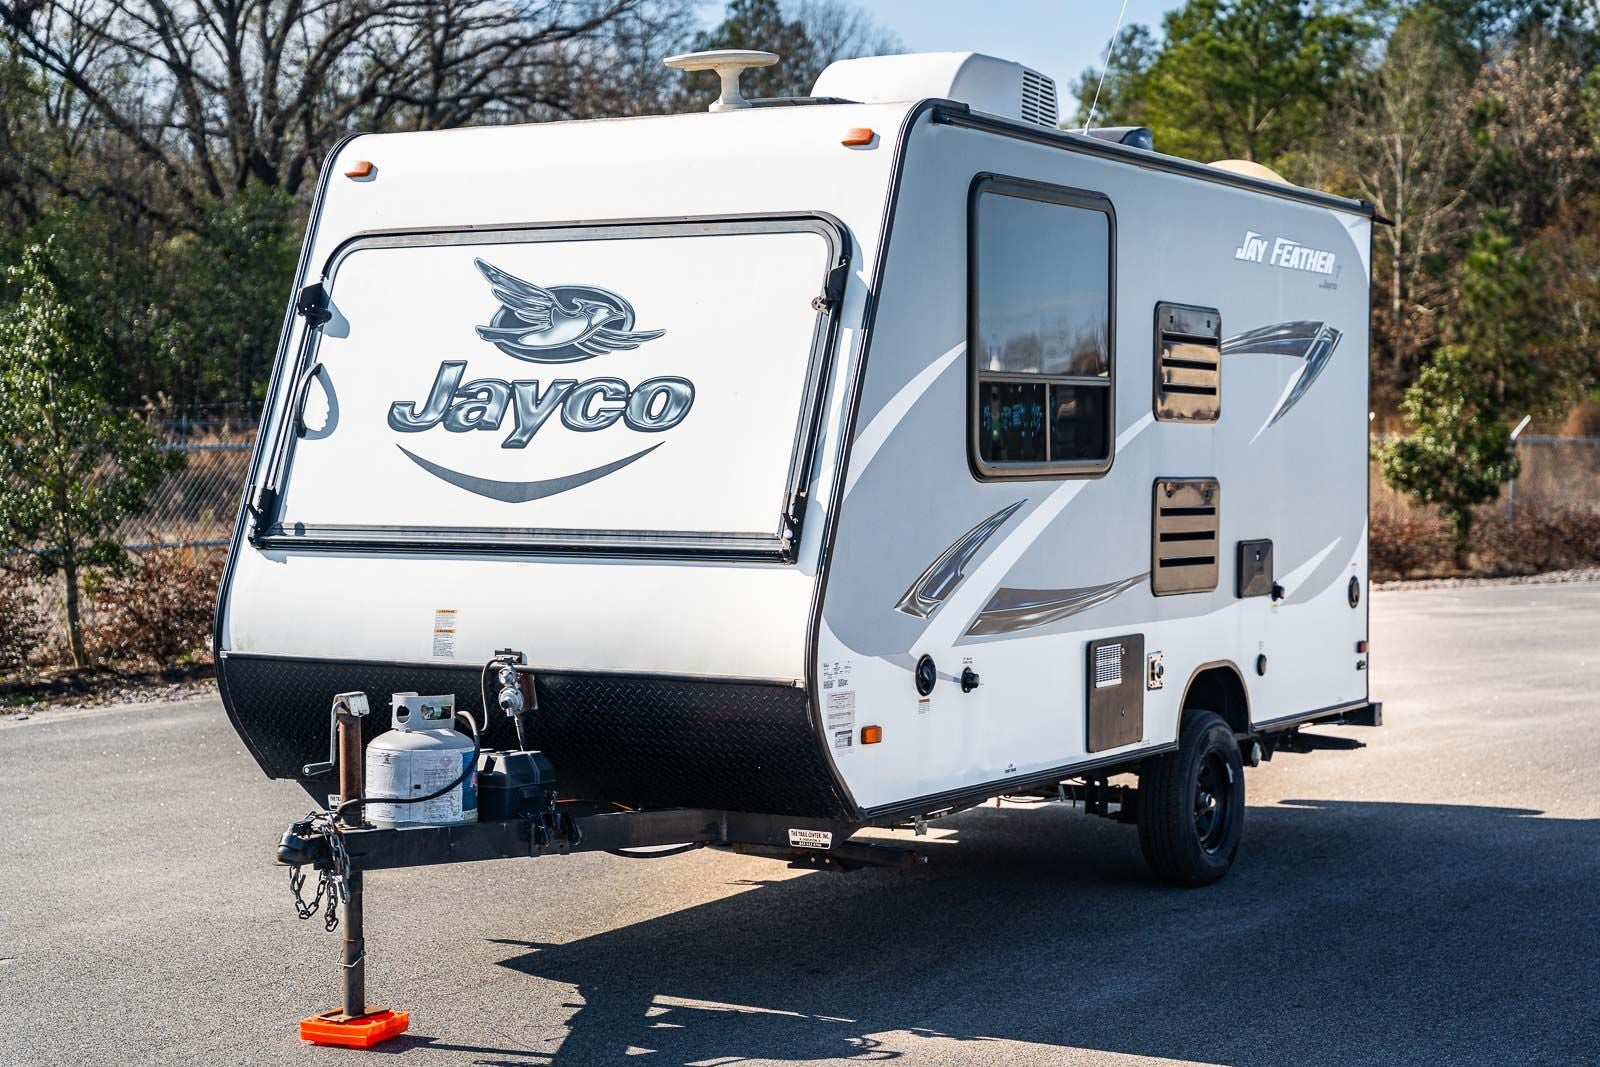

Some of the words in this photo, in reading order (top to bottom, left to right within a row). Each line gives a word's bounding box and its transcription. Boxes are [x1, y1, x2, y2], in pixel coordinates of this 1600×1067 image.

[1234, 231, 1268, 263] JAY
[1270, 237, 1335, 274] FEATHER
[387, 360, 695, 449] Jayco
